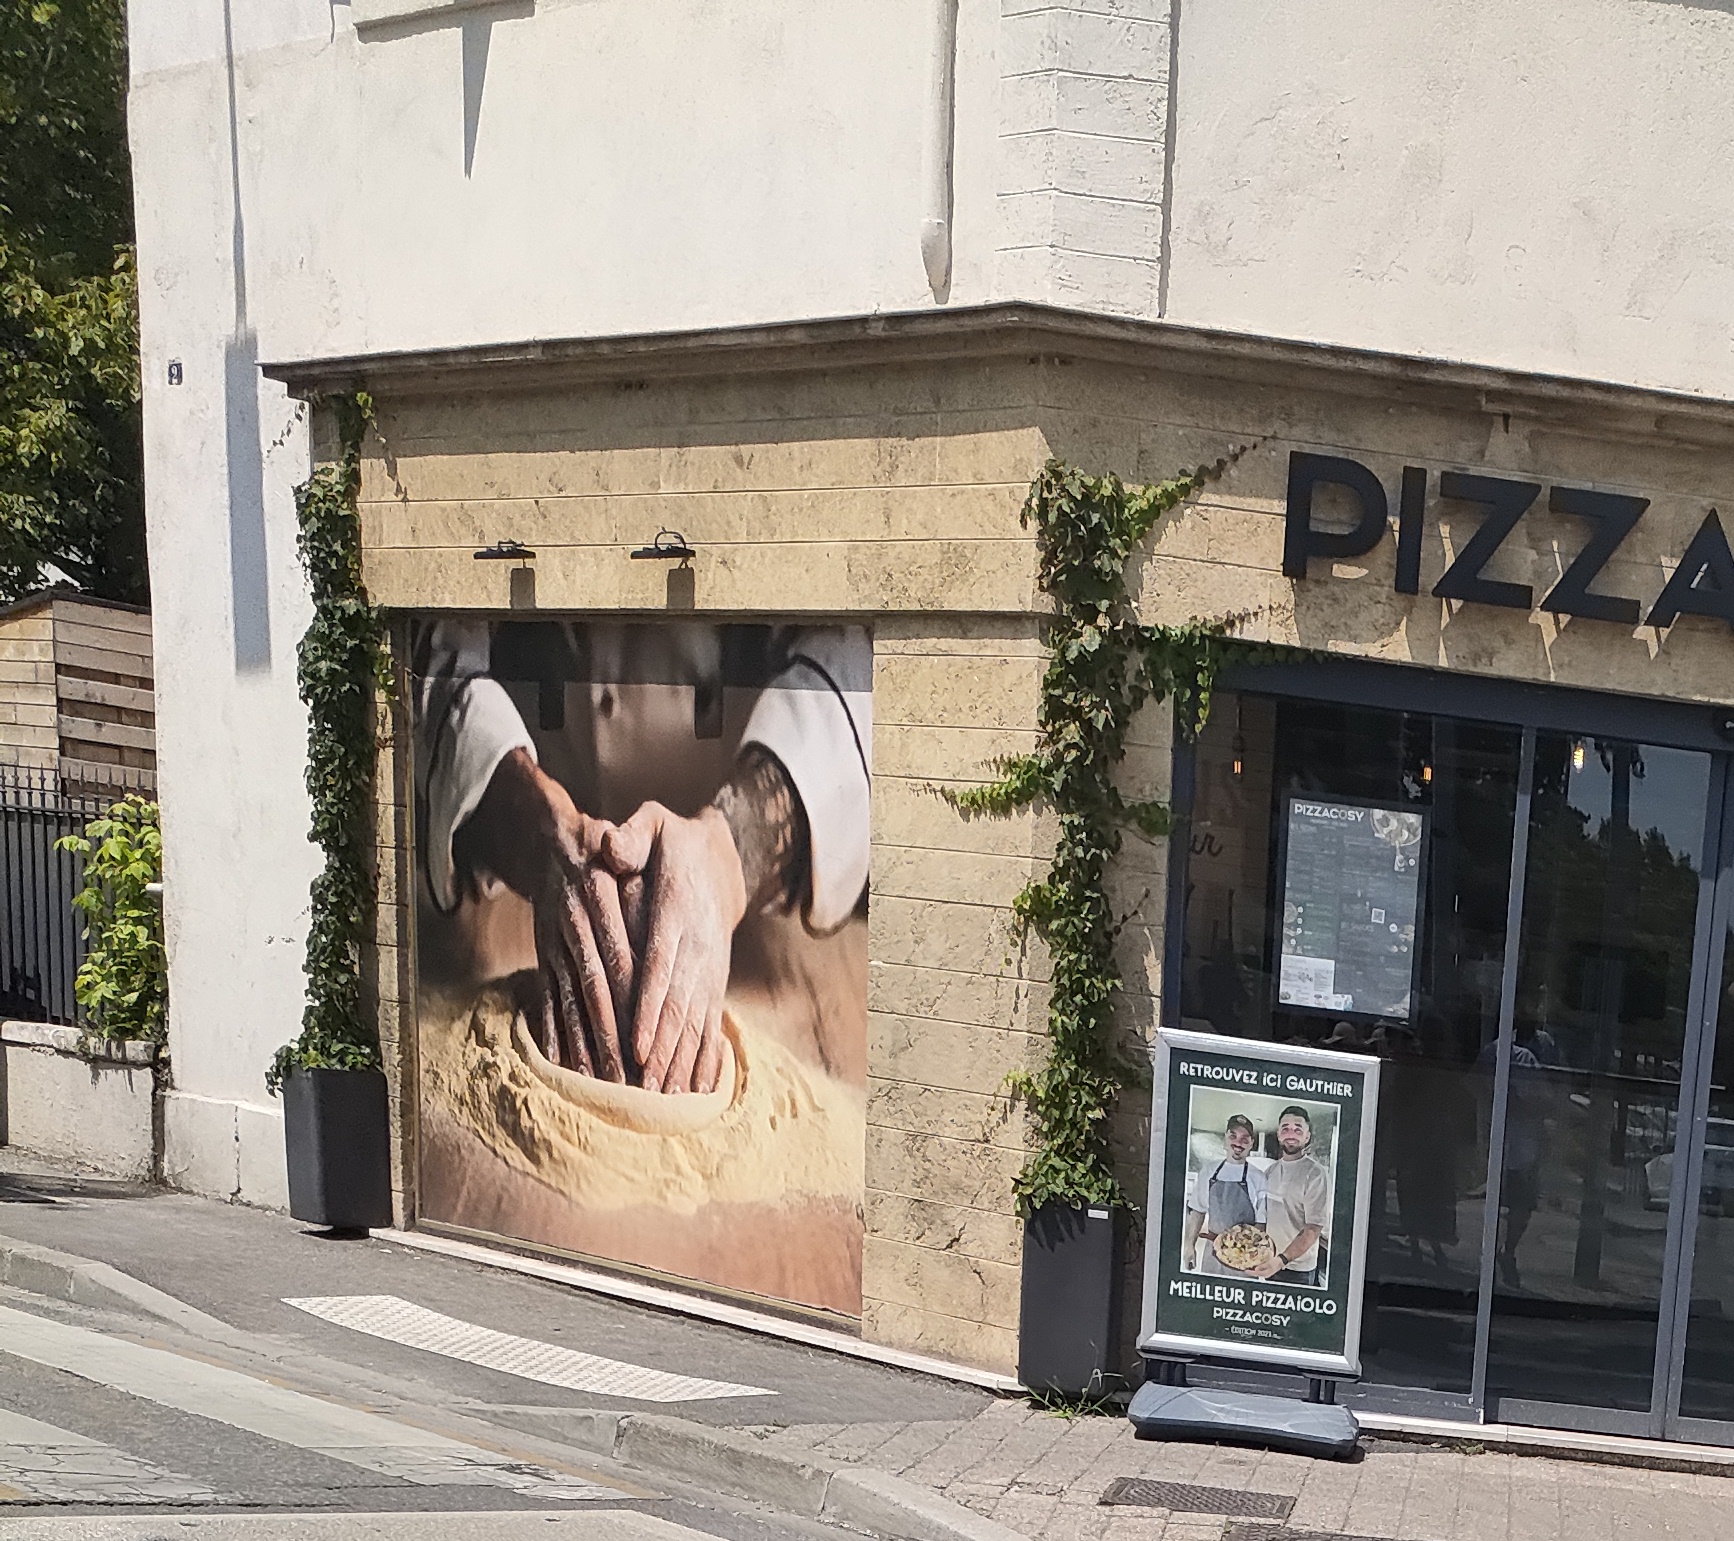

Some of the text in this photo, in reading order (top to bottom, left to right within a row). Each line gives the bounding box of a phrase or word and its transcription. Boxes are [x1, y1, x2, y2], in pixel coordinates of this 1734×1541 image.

[1295, 803, 1365, 822] PIZZACOSY
[1179, 1061, 1257, 1084] RETROUVEZ
[1213, 1307, 1291, 1327] PIZZACOSY
